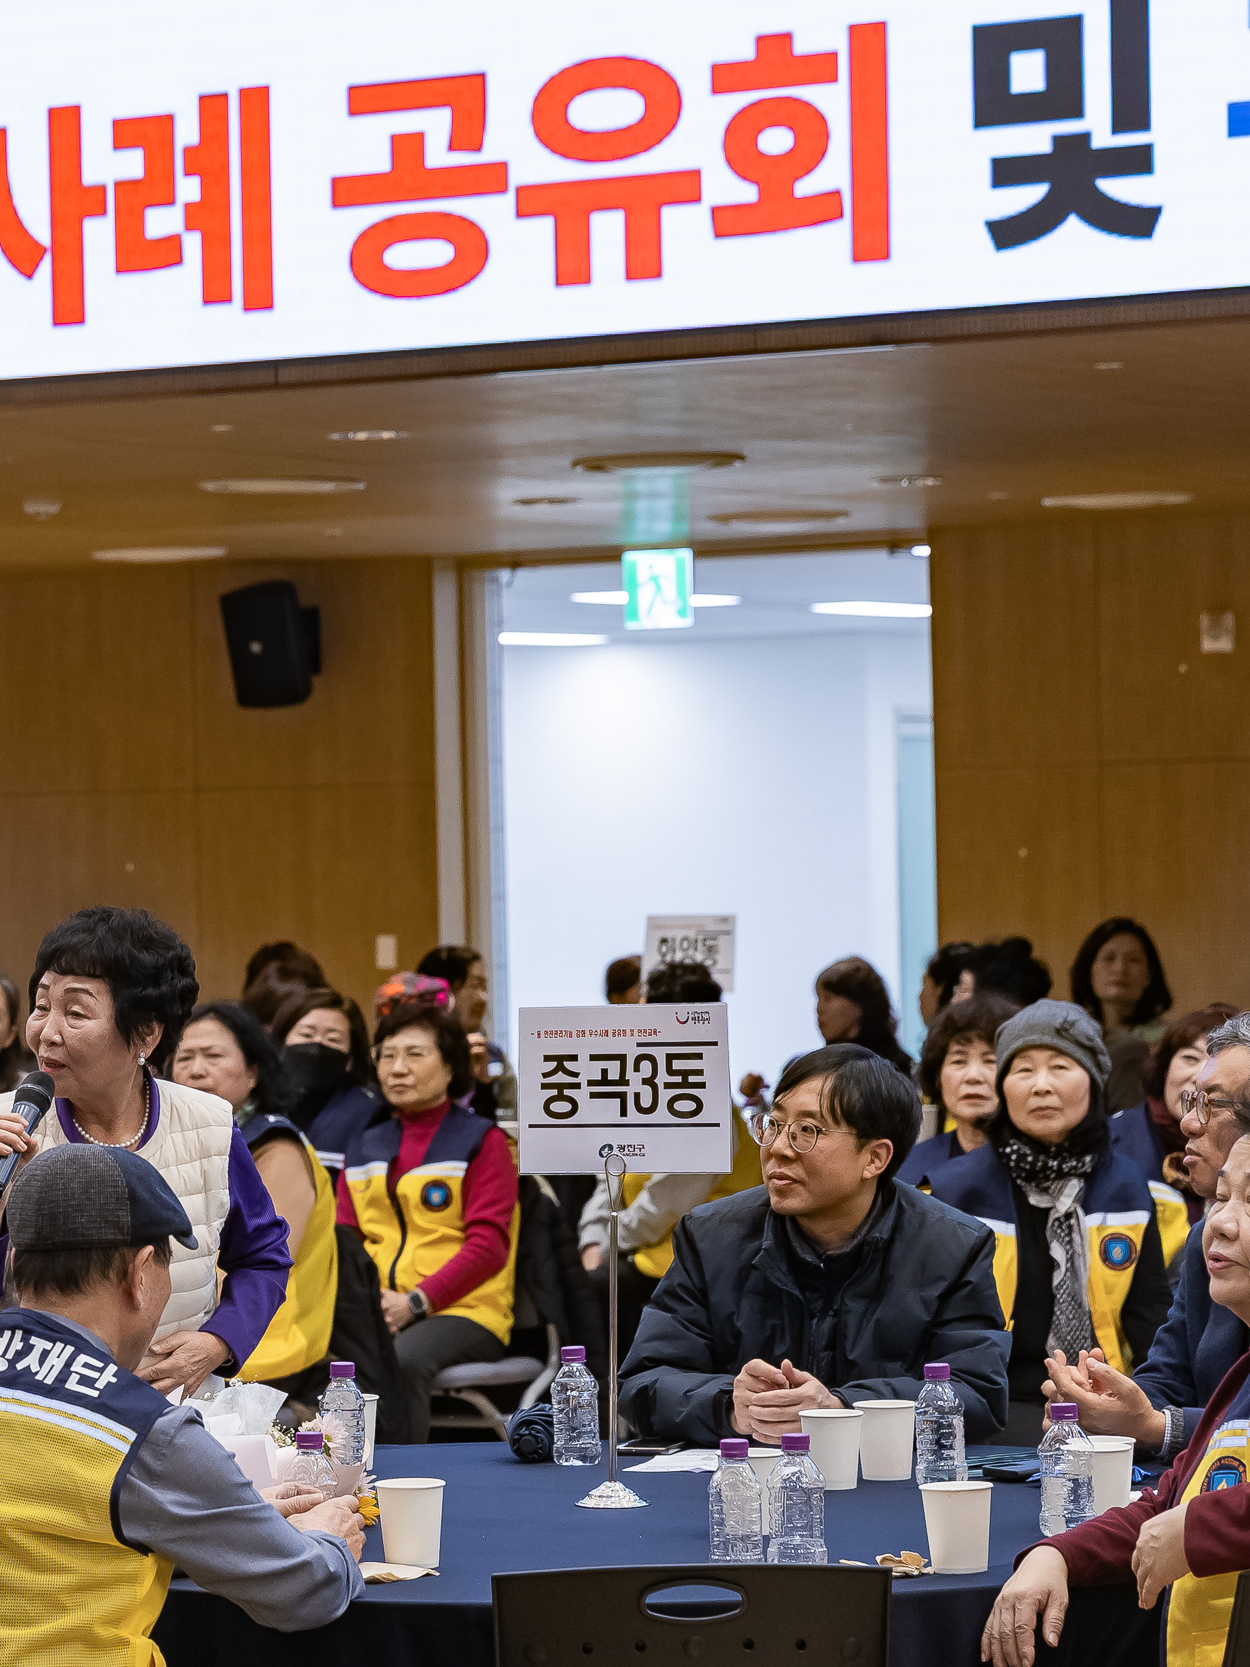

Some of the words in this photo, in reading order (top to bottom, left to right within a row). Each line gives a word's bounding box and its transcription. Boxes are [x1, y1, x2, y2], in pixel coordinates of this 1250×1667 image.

[332, 21, 891, 299] 공유회
[972, 0, 1163, 252] 및
[575, 1029, 586, 1038] 강화
[588, 1028, 609, 1038] 우수사례
[611, 1028, 627, 1038] 공유회
[540, 1052, 707, 1120] 중곡3동
[616, 1143, 646, 1153] 광진구
